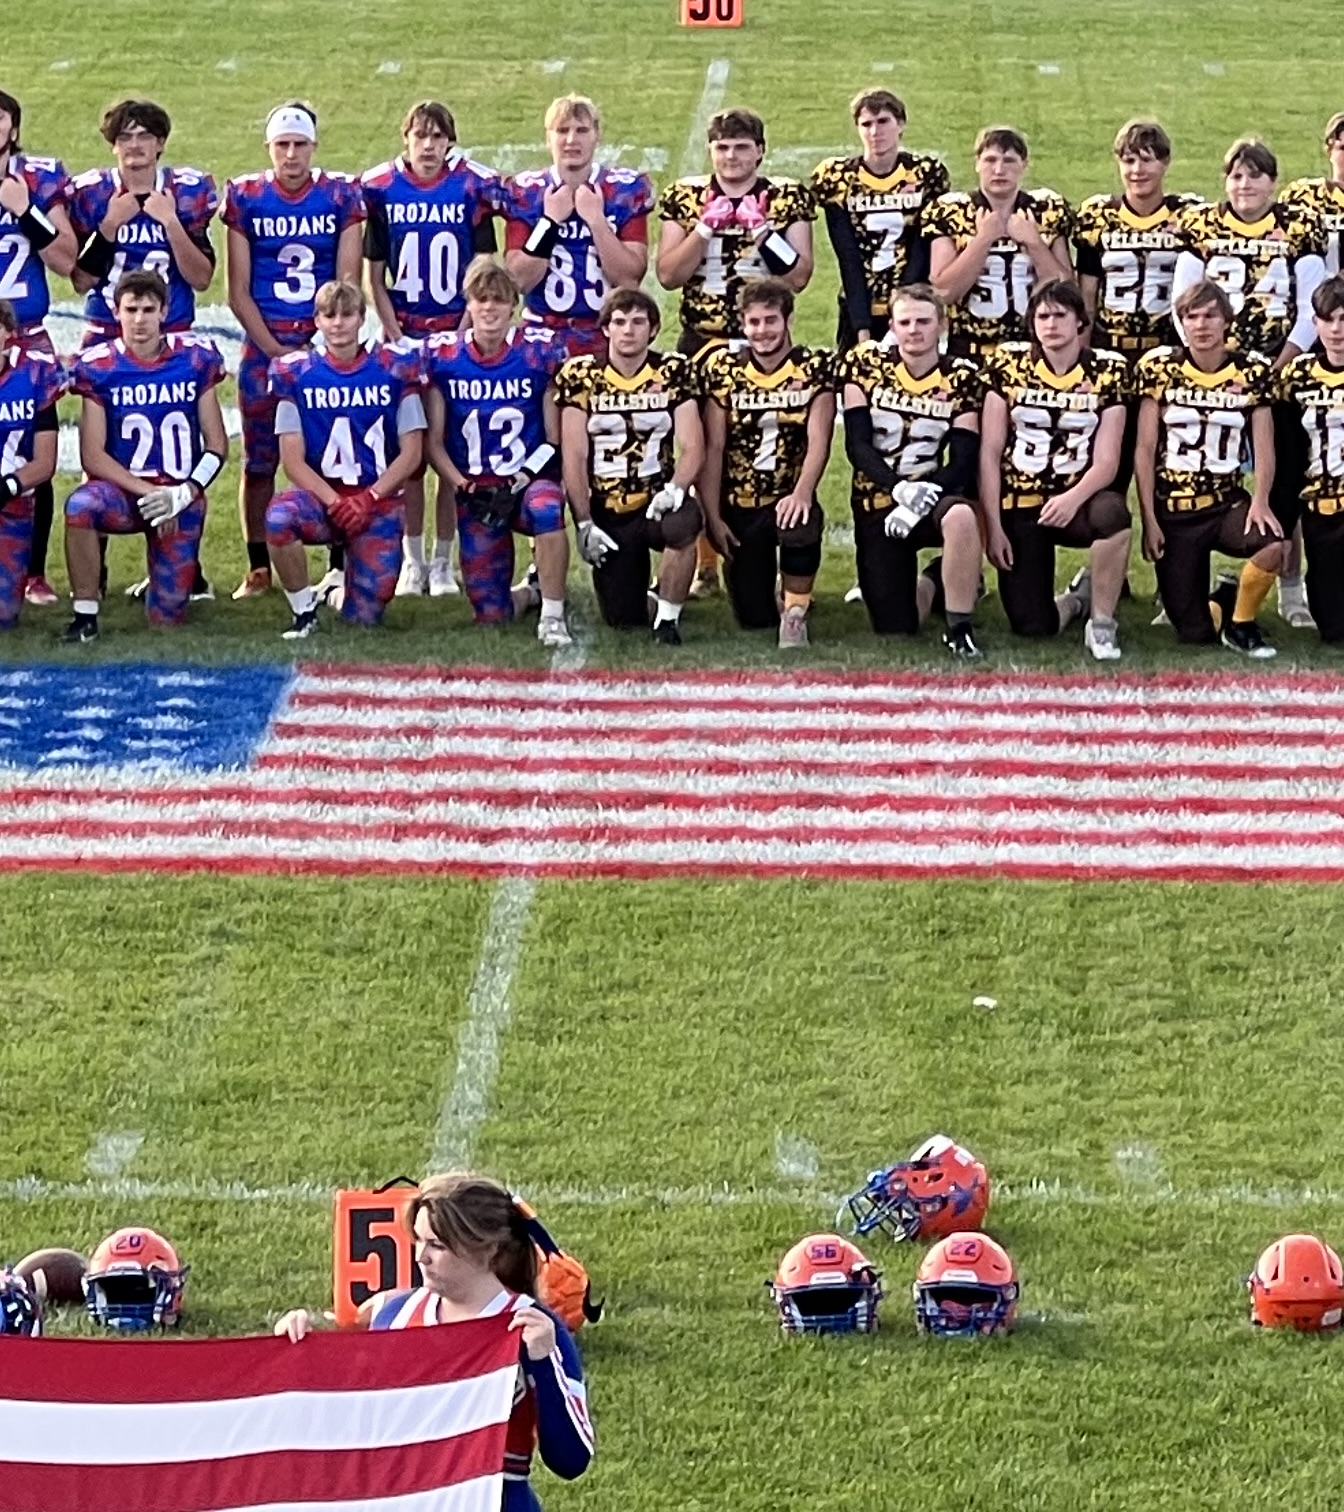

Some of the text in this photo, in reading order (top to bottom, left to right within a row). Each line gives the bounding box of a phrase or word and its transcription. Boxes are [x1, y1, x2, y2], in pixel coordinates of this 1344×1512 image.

[253, 214, 337, 238] TROJANS
[385, 203, 465, 225] TROJANS
[865, 211, 906, 272] 7
[1102, 231, 1175, 251] PELLSTO
[273, 244, 316, 304] 3
[393, 231, 460, 305] 40
[545, 244, 607, 313] 85
[110, 381, 197, 405] TROJANS
[303, 384, 391, 409] TROJANS
[449, 378, 533, 400] TROJANS
[729, 390, 810, 410] PELLSTON
[1014, 387, 1099, 410] PELLSTON
[1165, 387, 1249, 409] PELLSTON
[589, 392, 670, 413] PELLSTON
[871, 387, 954, 419] PELLSTON
[121, 411, 194, 480] 20
[320, 415, 387, 486] 41
[461, 406, 527, 477] 13
[587, 411, 674, 478] 27
[1011, 406, 1099, 475] 63
[1162, 406, 1246, 475] 20
[115, 1236, 142, 1250] 20
[949, 1241, 976, 1257] 22
